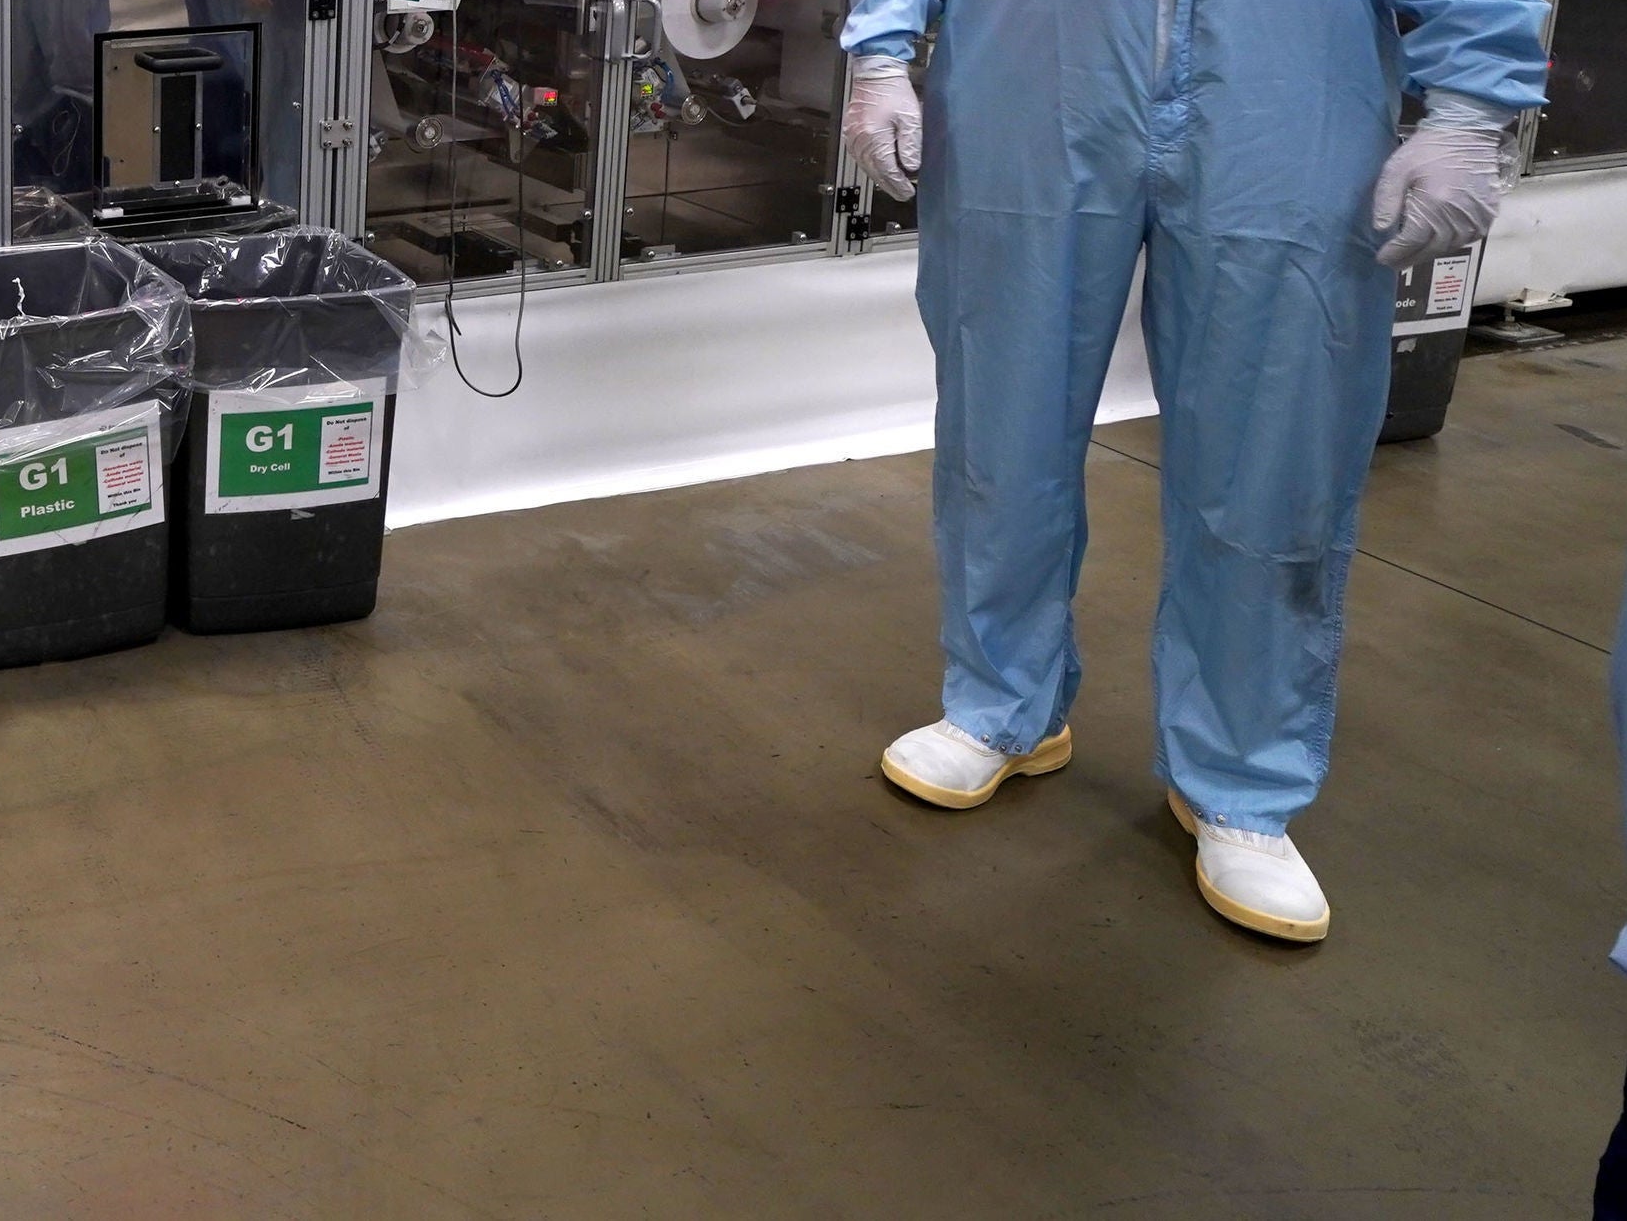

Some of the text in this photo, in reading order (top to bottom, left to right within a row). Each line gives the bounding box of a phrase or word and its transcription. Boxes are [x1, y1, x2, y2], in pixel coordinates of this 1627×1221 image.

[246, 423, 293, 453] G1
[19, 457, 68, 491] G1
[250, 463, 290, 474] Dry Cell
[21, 499, 75, 518] Plastic
